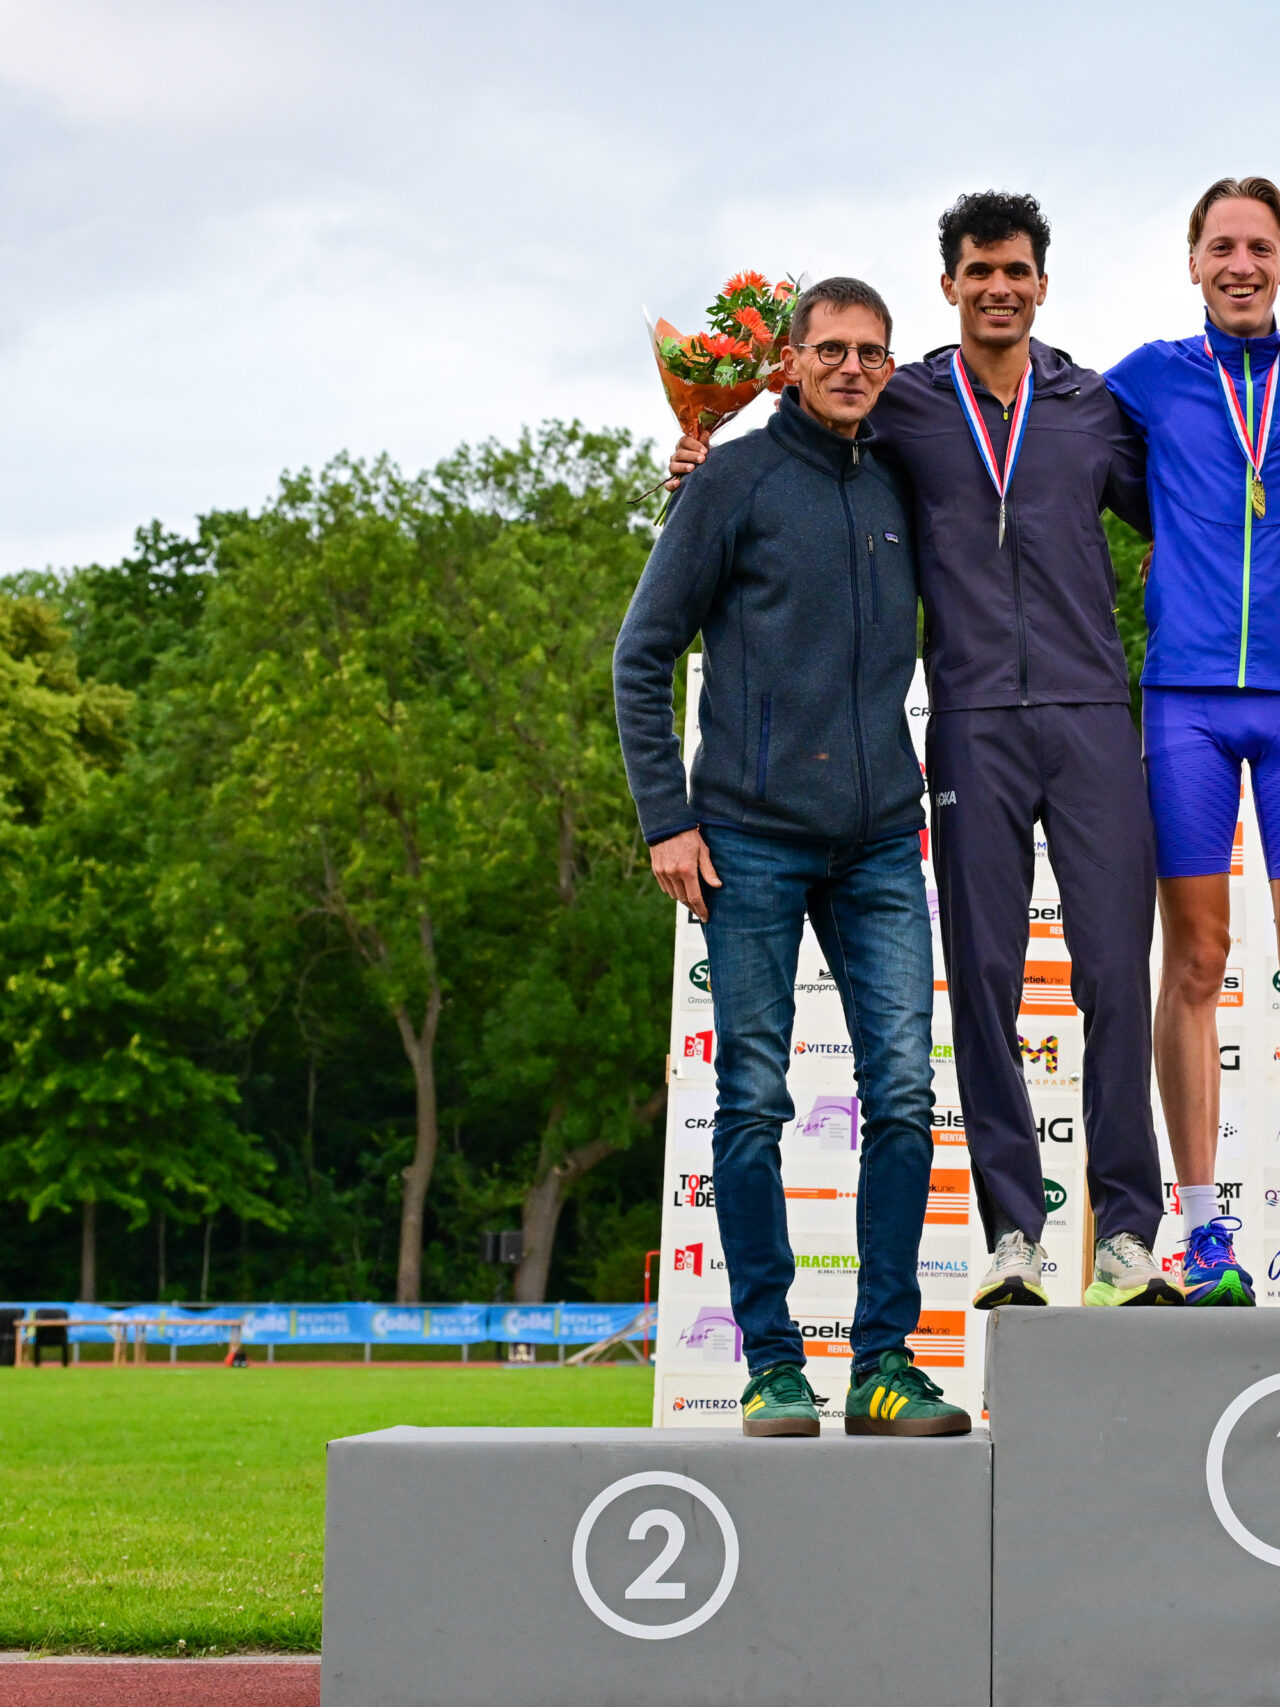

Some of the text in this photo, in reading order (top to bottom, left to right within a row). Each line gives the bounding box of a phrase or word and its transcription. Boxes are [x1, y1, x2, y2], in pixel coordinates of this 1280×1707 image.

[936, 790, 957, 808] HOKA
[686, 1399, 738, 1409] VITERZO
[624, 1508, 686, 1599] 2
